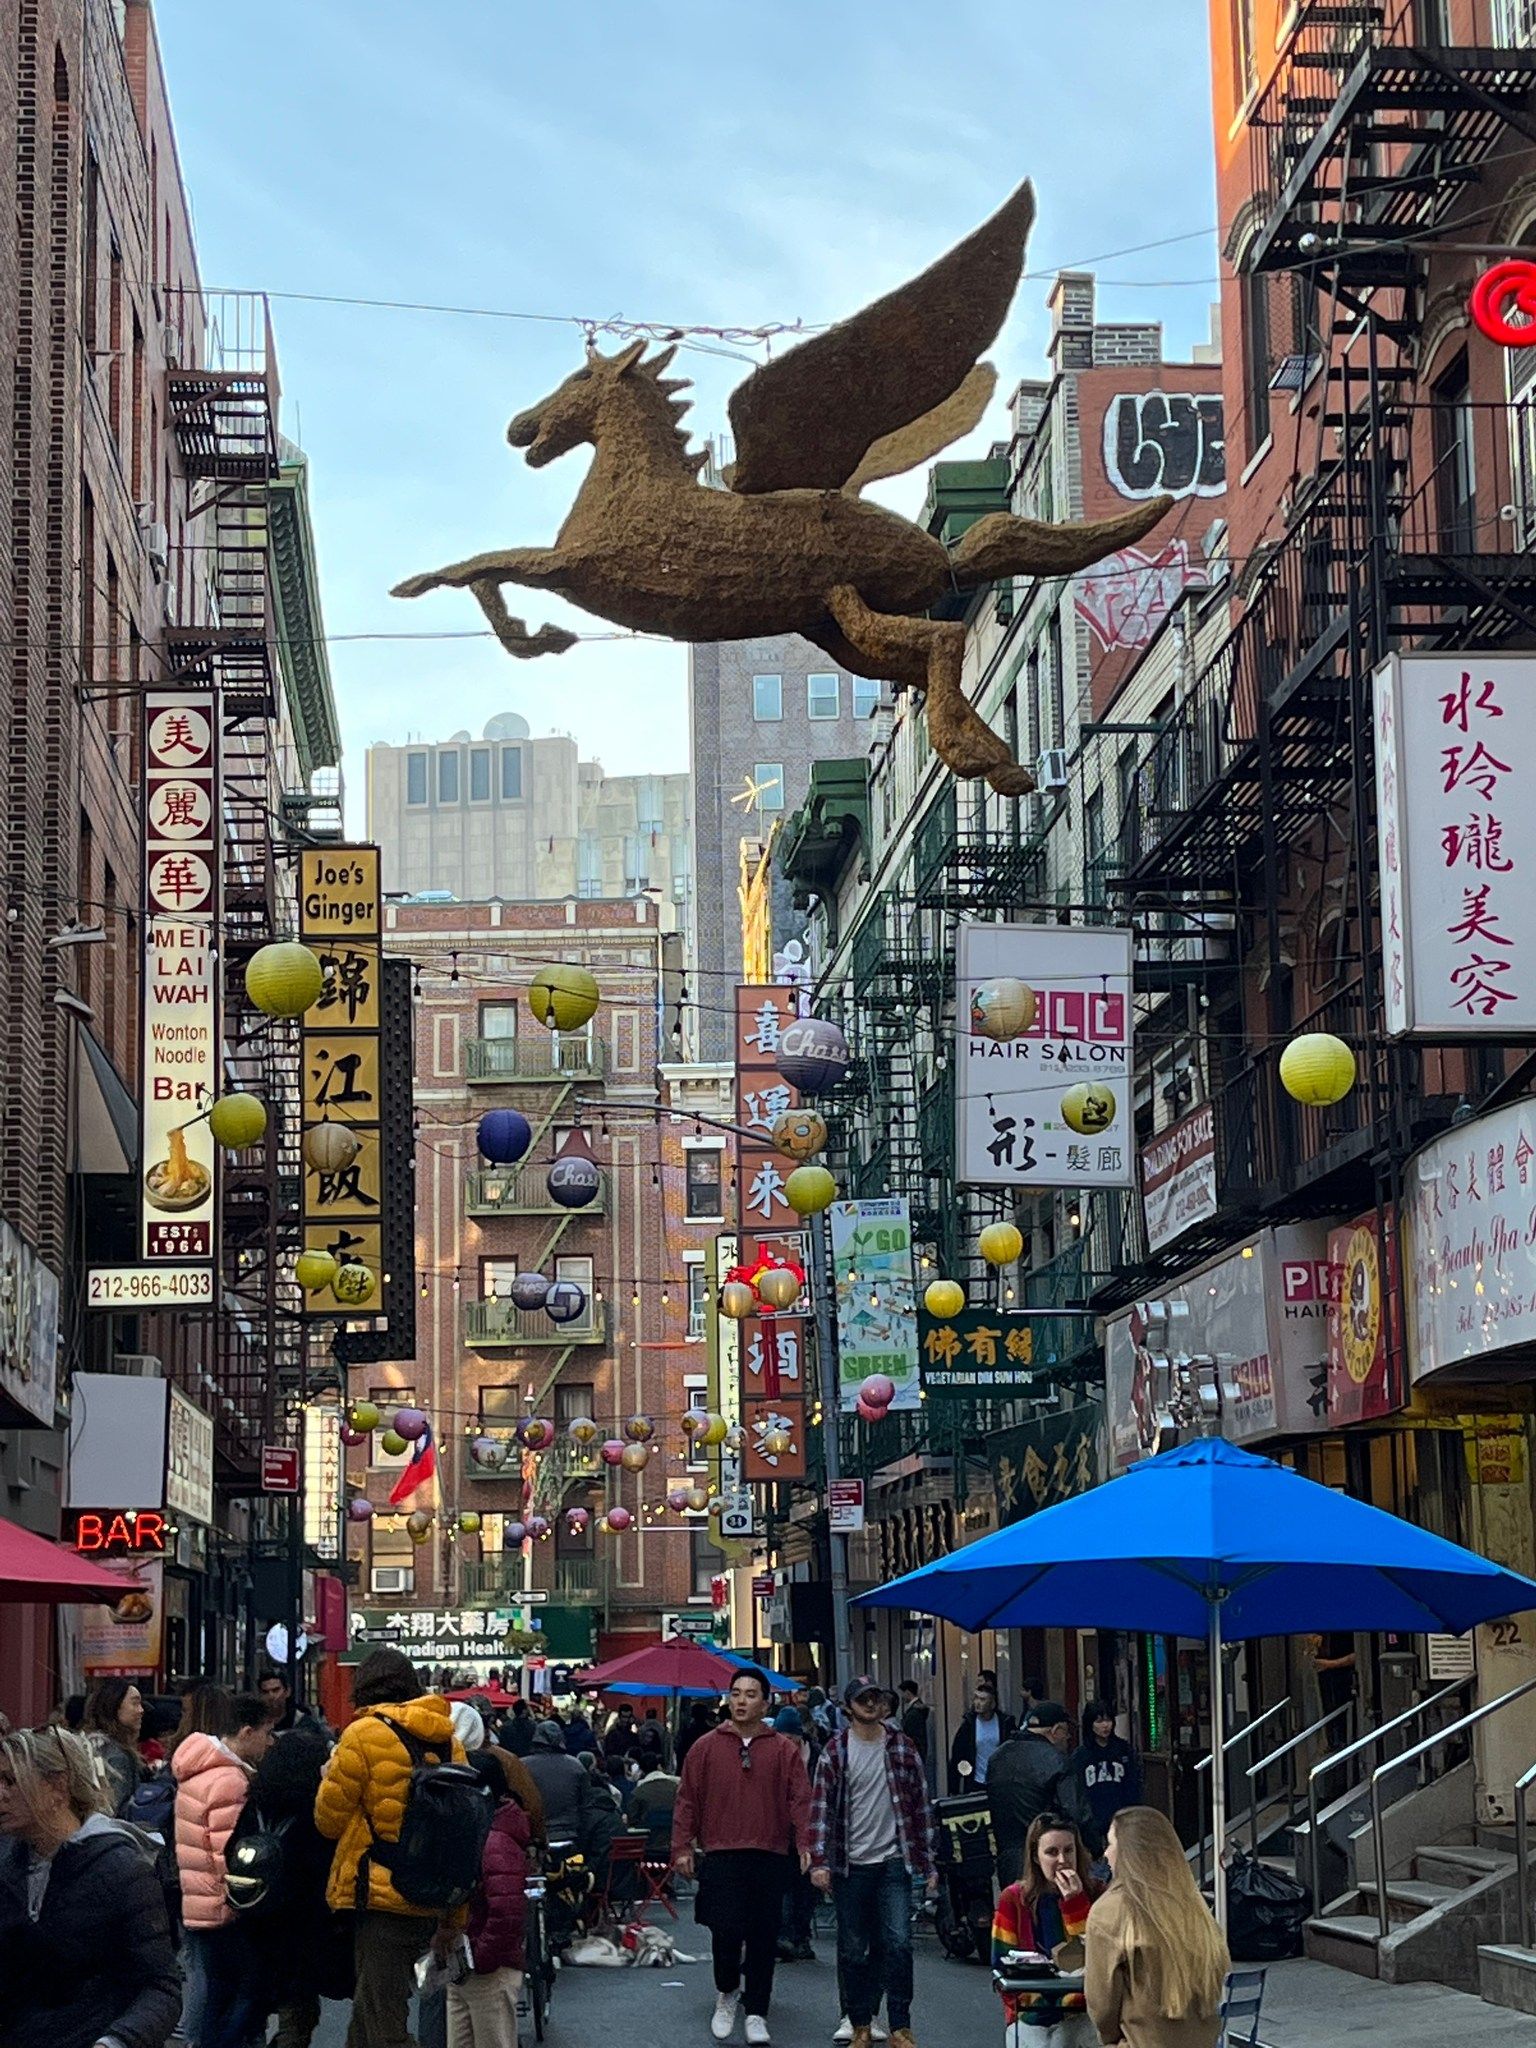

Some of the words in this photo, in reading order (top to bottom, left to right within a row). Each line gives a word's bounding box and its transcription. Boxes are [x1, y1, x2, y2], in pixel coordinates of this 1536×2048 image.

[154, 713, 206, 908] 美麗華
[1438, 671, 1518, 1016] 水玲瓏美容
[314, 859, 364, 886] Joe's
[304, 893, 374, 926] Ginger
[155, 928, 205, 948] MEI
[157, 956, 204, 976] LAI
[153, 984, 208, 1004] WAH
[151, 1022, 208, 1041] Wonton
[154, 1046, 206, 1064] Noodle
[969, 1041, 1030, 1059] HAIR
[1041, 1043, 1125, 1062] SALON
[153, 1076, 206, 1101] Bar
[551, 1163, 597, 1187] Chas
[157, 1226, 198, 1238] EST:
[876, 1228, 906, 1251] GO
[151, 1241, 203, 1253] 1964
[91, 1273, 211, 1299] 212-966-4033
[843, 1354, 907, 1379] GREEN
[77, 1513, 165, 1551] BAR
[1491, 1620, 1522, 1646] 22
[1085, 1760, 1125, 1787] GAP
